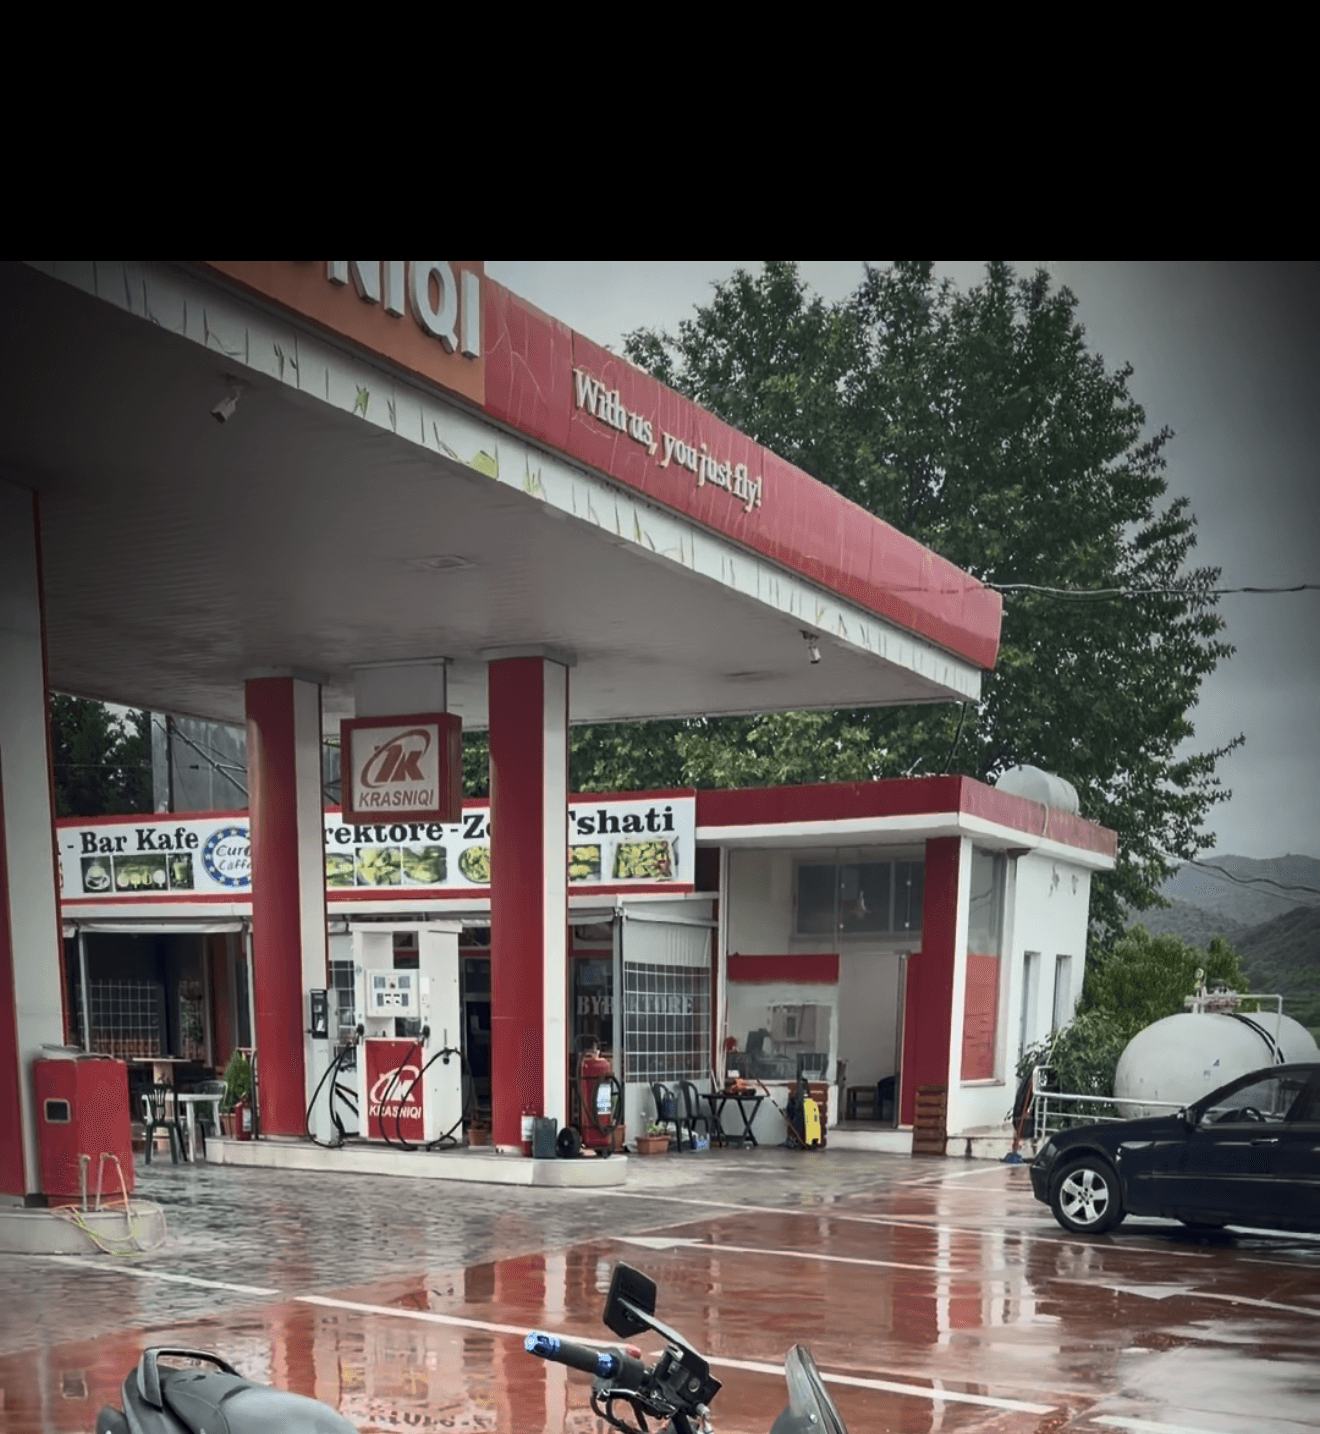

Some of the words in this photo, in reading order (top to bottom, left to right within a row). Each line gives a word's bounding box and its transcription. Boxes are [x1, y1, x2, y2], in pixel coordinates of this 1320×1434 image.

[573, 368, 628, 433] With
[628, 412, 659, 457] us,
[657, 430, 698, 474] you
[697, 443, 733, 493] just
[732, 461, 763, 514] fly!
[358, 788, 435, 808] KRASNIQI
[79, 831, 128, 855] Bar
[135, 827, 199, 852] Kafe
